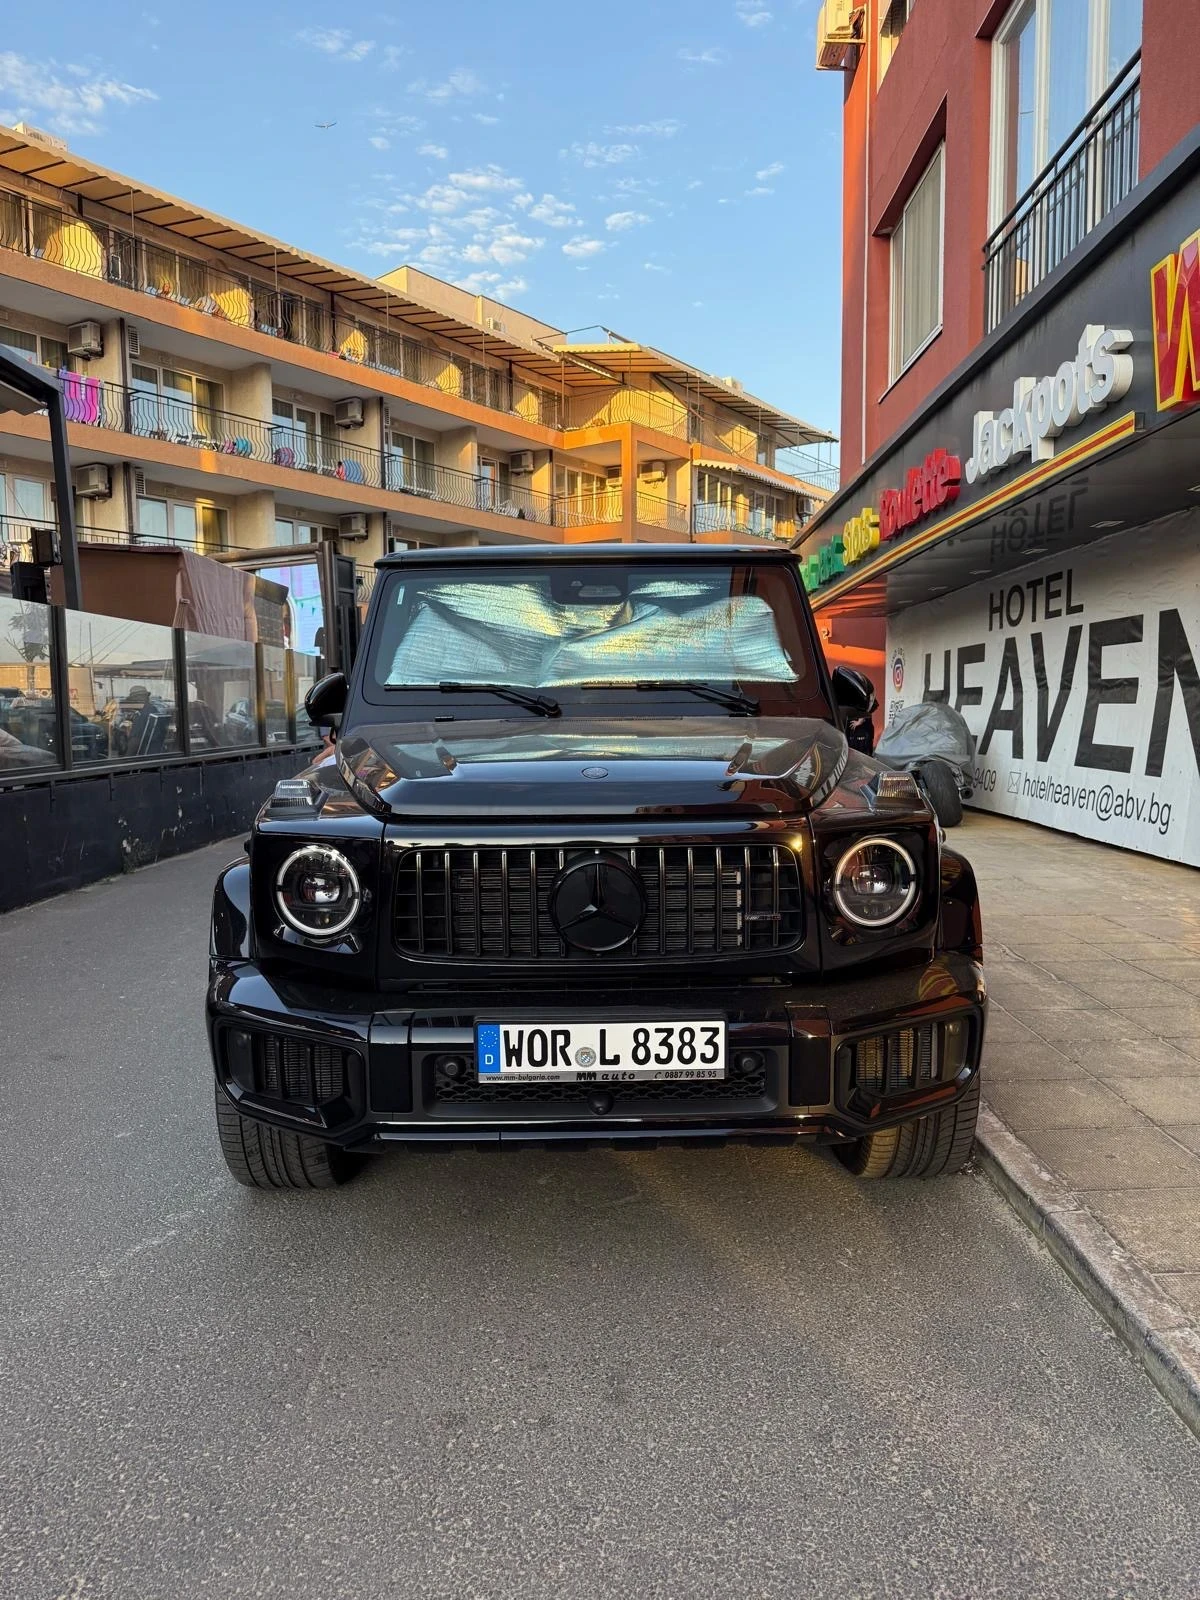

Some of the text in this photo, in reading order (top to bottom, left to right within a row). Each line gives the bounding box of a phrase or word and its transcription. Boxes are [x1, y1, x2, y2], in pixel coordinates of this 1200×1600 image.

[965, 324, 1134, 484] Jackpots
[880, 448, 961, 541] Roulette
[842, 507, 880, 566] Slots
[988, 568, 1084, 632] HOTEL
[1022, 771, 1172, 835] hotelheaven@abv.bg
[484, 1027, 720, 1067] D WOR L 8383
[601, 1071, 636, 1081] auto
[664, 1070, 682, 1079] 0887
[685, 1070, 695, 1079] 99
[696, 1070, 706, 1079] 85
[707, 1070, 717, 1079] 95
